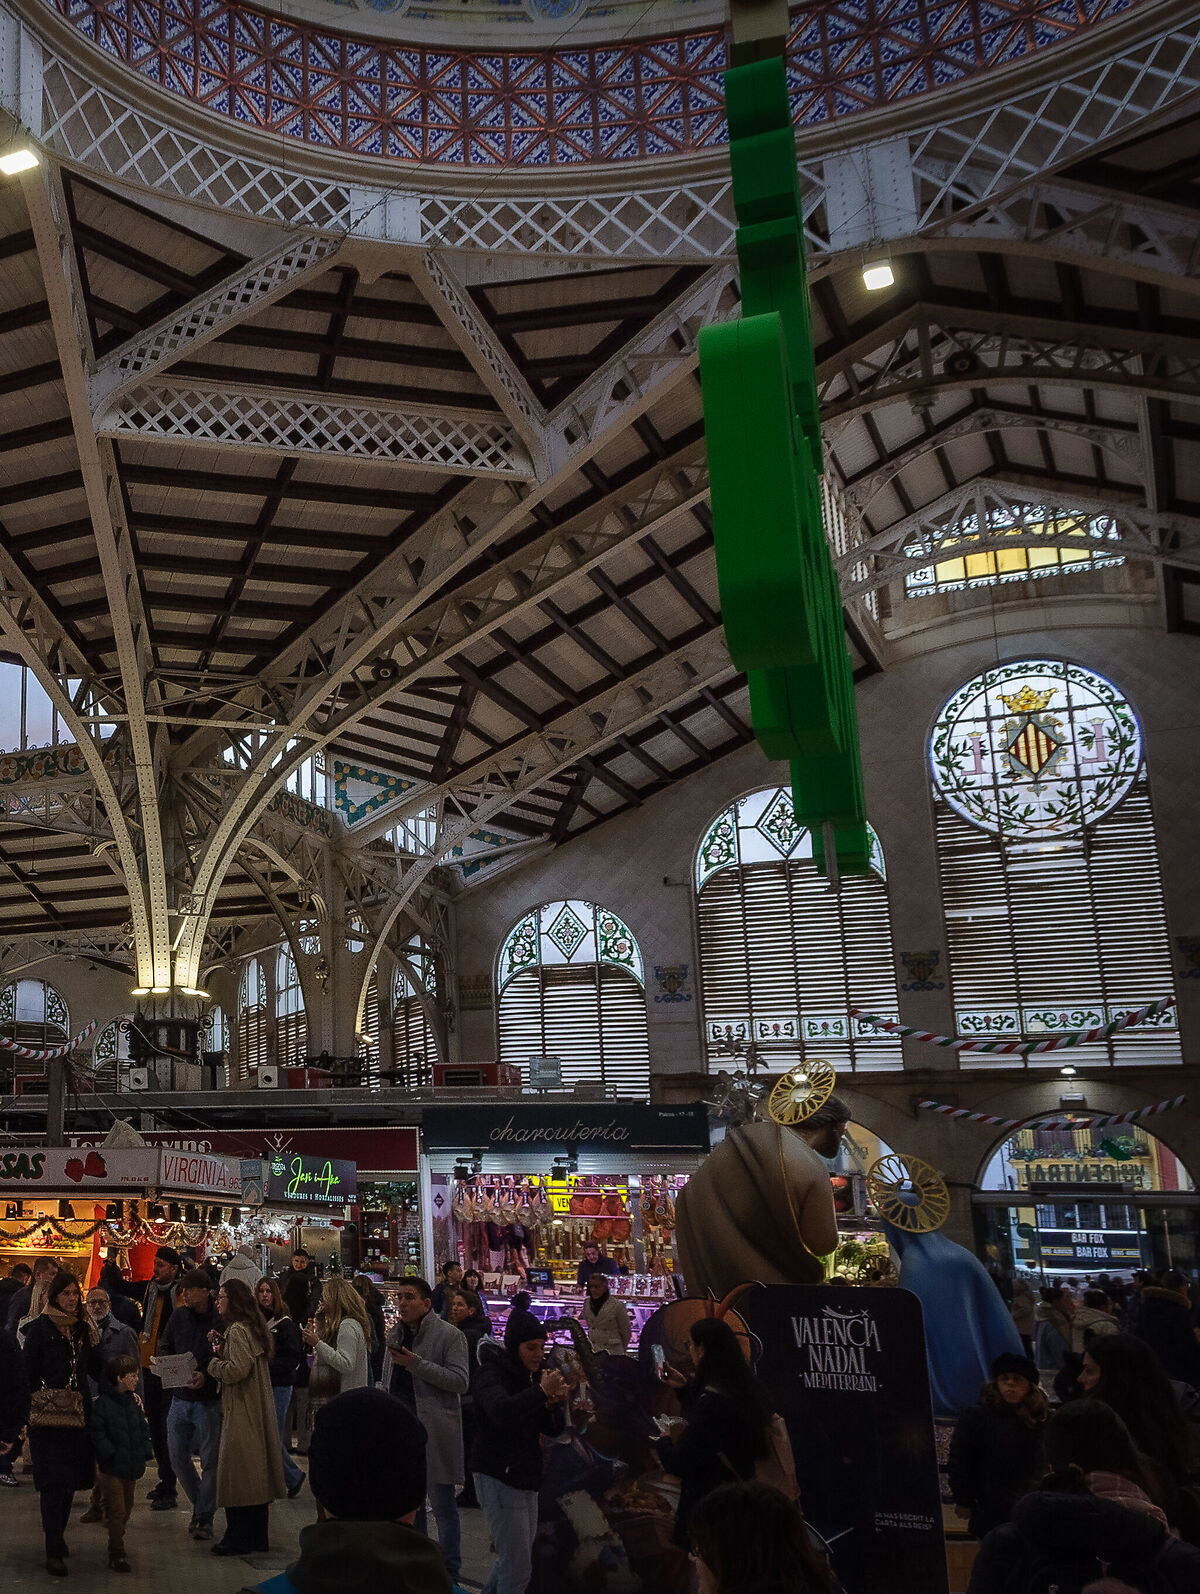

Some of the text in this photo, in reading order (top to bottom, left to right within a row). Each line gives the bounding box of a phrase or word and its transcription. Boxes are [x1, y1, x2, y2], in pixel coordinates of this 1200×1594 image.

[489, 1115, 631, 1142] charcutería
[164, 1155, 226, 1187] VIRGINIA
[1071, 1232, 1104, 1244] BAR FOX
[1075, 1246, 1092, 1258] BAR
[1093, 1247, 1109, 1258] FOX
[808, 1344, 871, 1375] NADAL
[803, 1372, 877, 1392] MEDITERRANI
